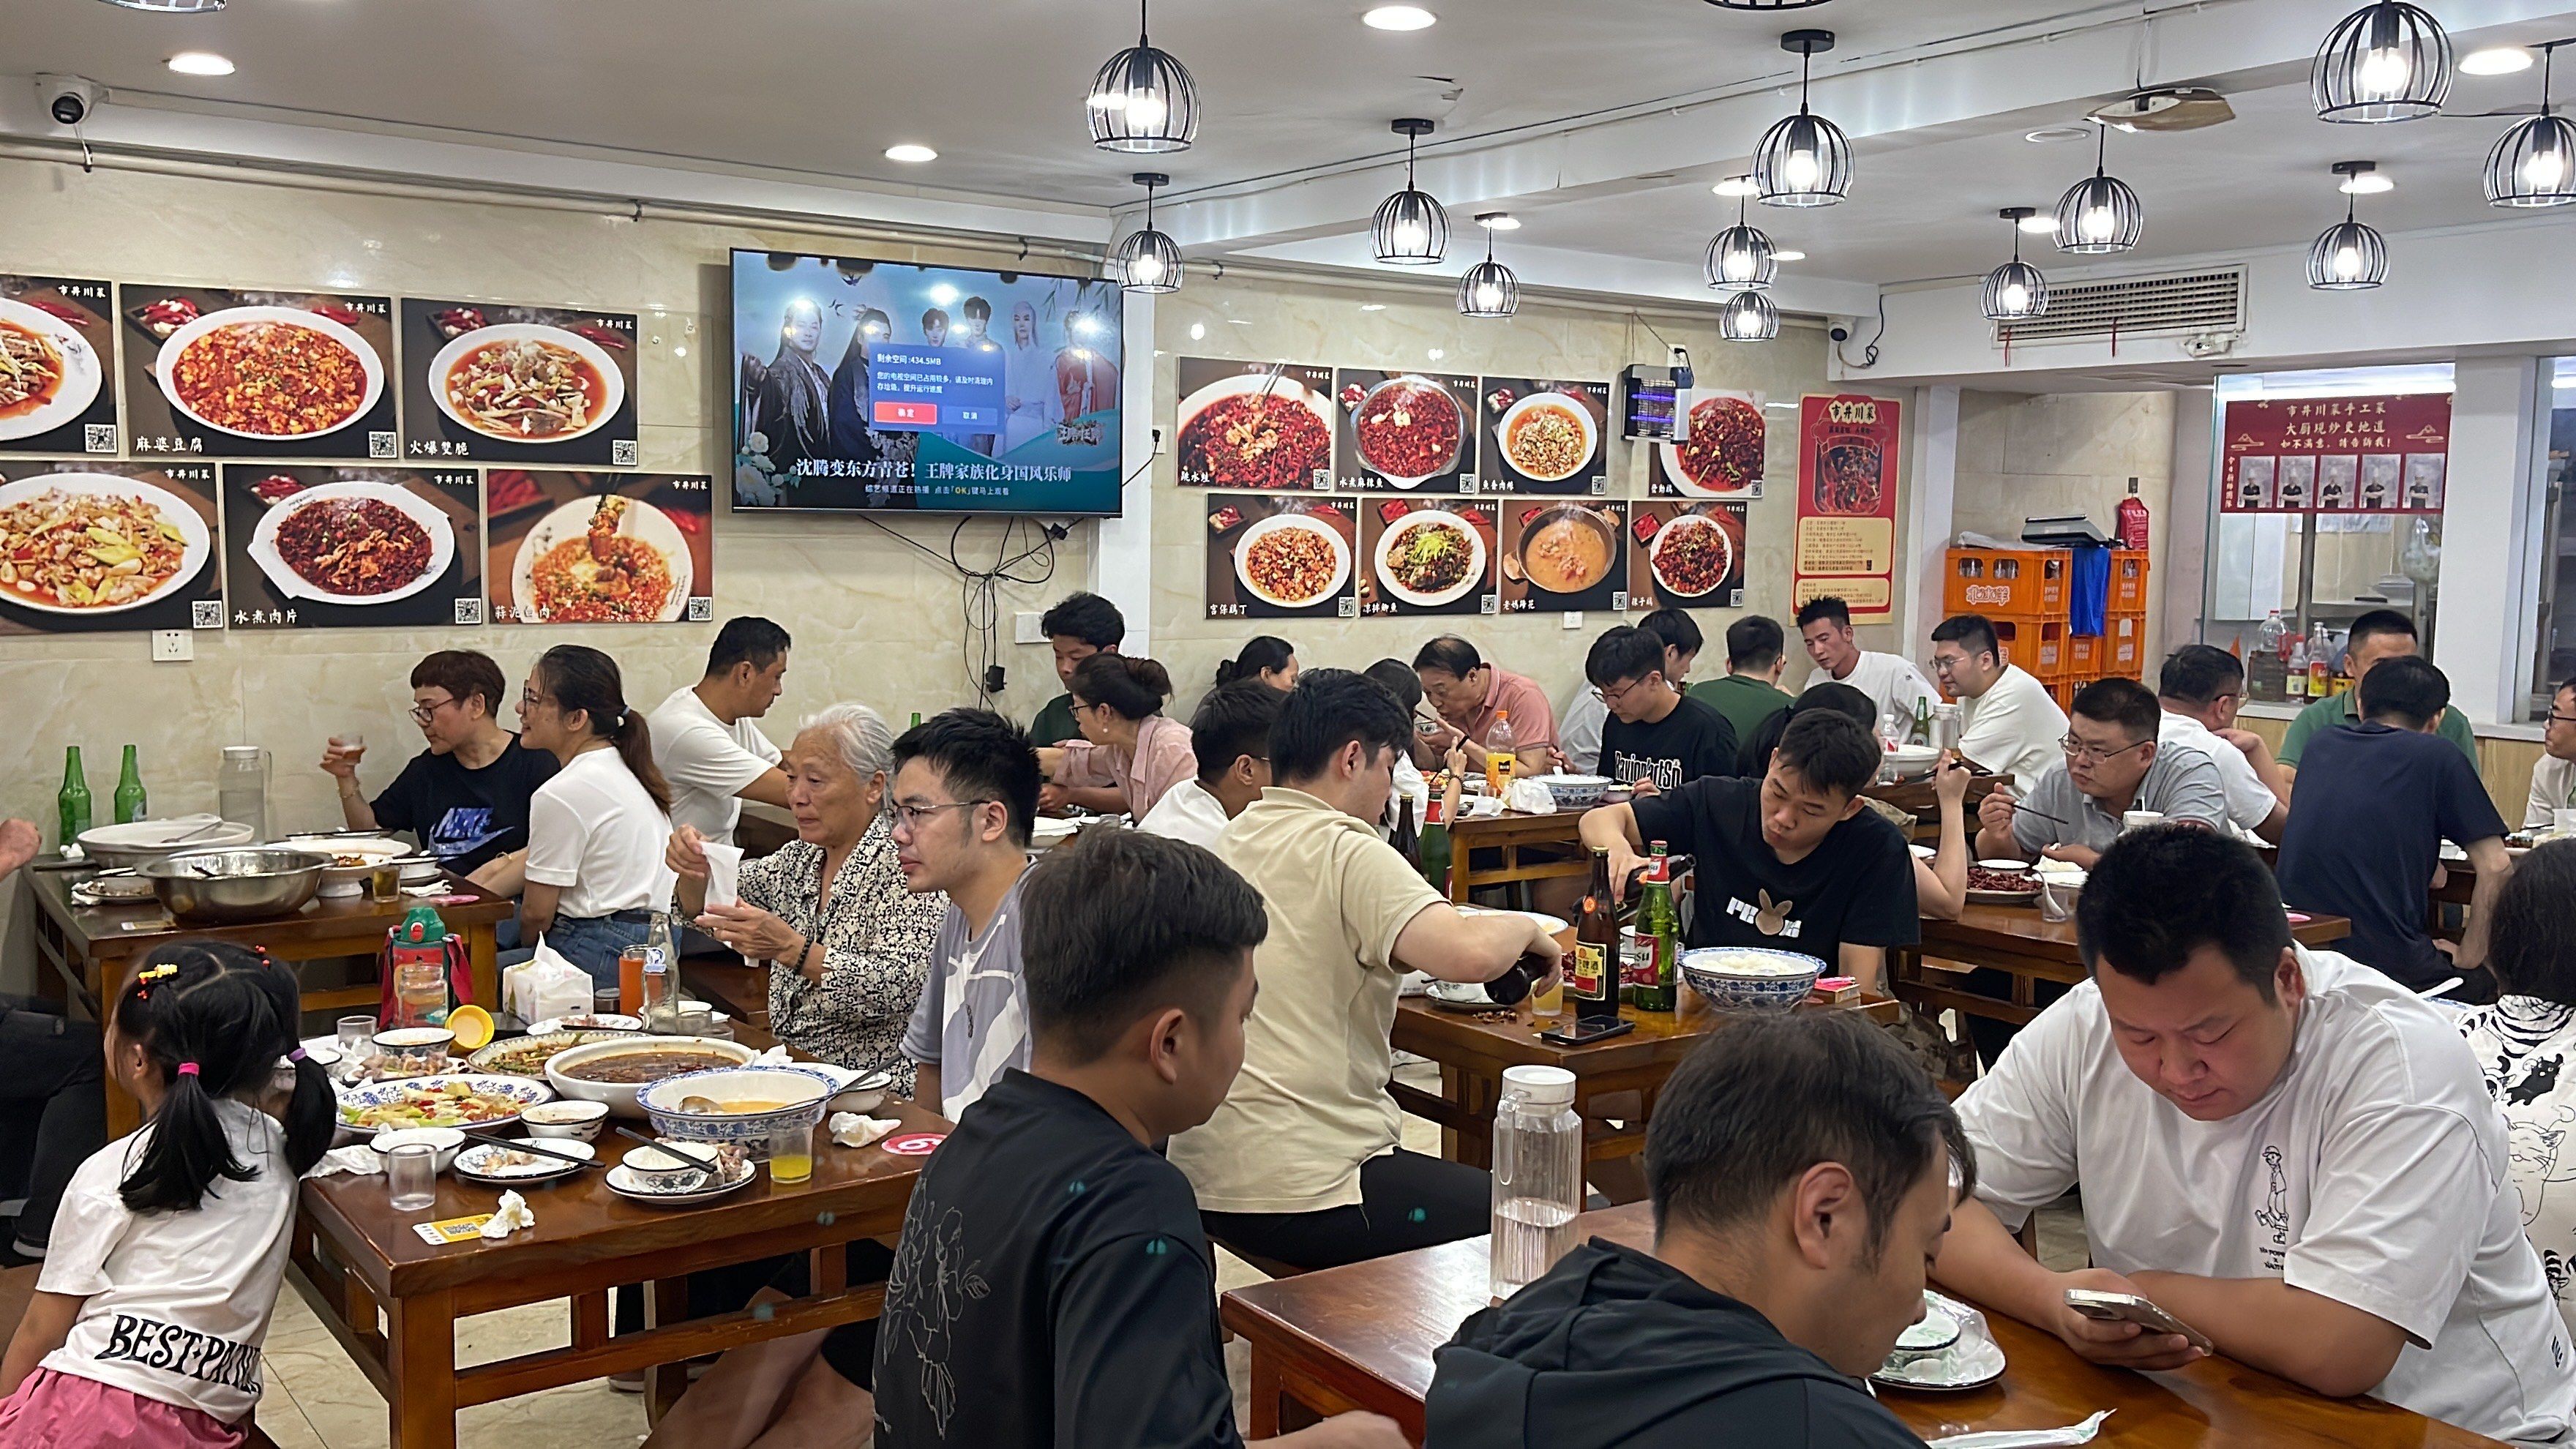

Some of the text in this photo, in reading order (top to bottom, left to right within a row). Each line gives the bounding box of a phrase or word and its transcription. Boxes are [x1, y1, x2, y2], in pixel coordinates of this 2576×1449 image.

[59, 285, 105, 298] 市井川菜
[345, 302, 386, 314] 市井川菜
[596, 318, 632, 329] 市井川菜
[1831, 403, 1874, 421] 市井川菜
[135, 435, 203, 453] 麻婆豆腐
[165, 468, 210, 480] 市井川菜
[434, 473, 473, 484] 市井川菜
[672, 480, 708, 490] 市井川菜
[234, 608, 297, 624] 水煮肉片
